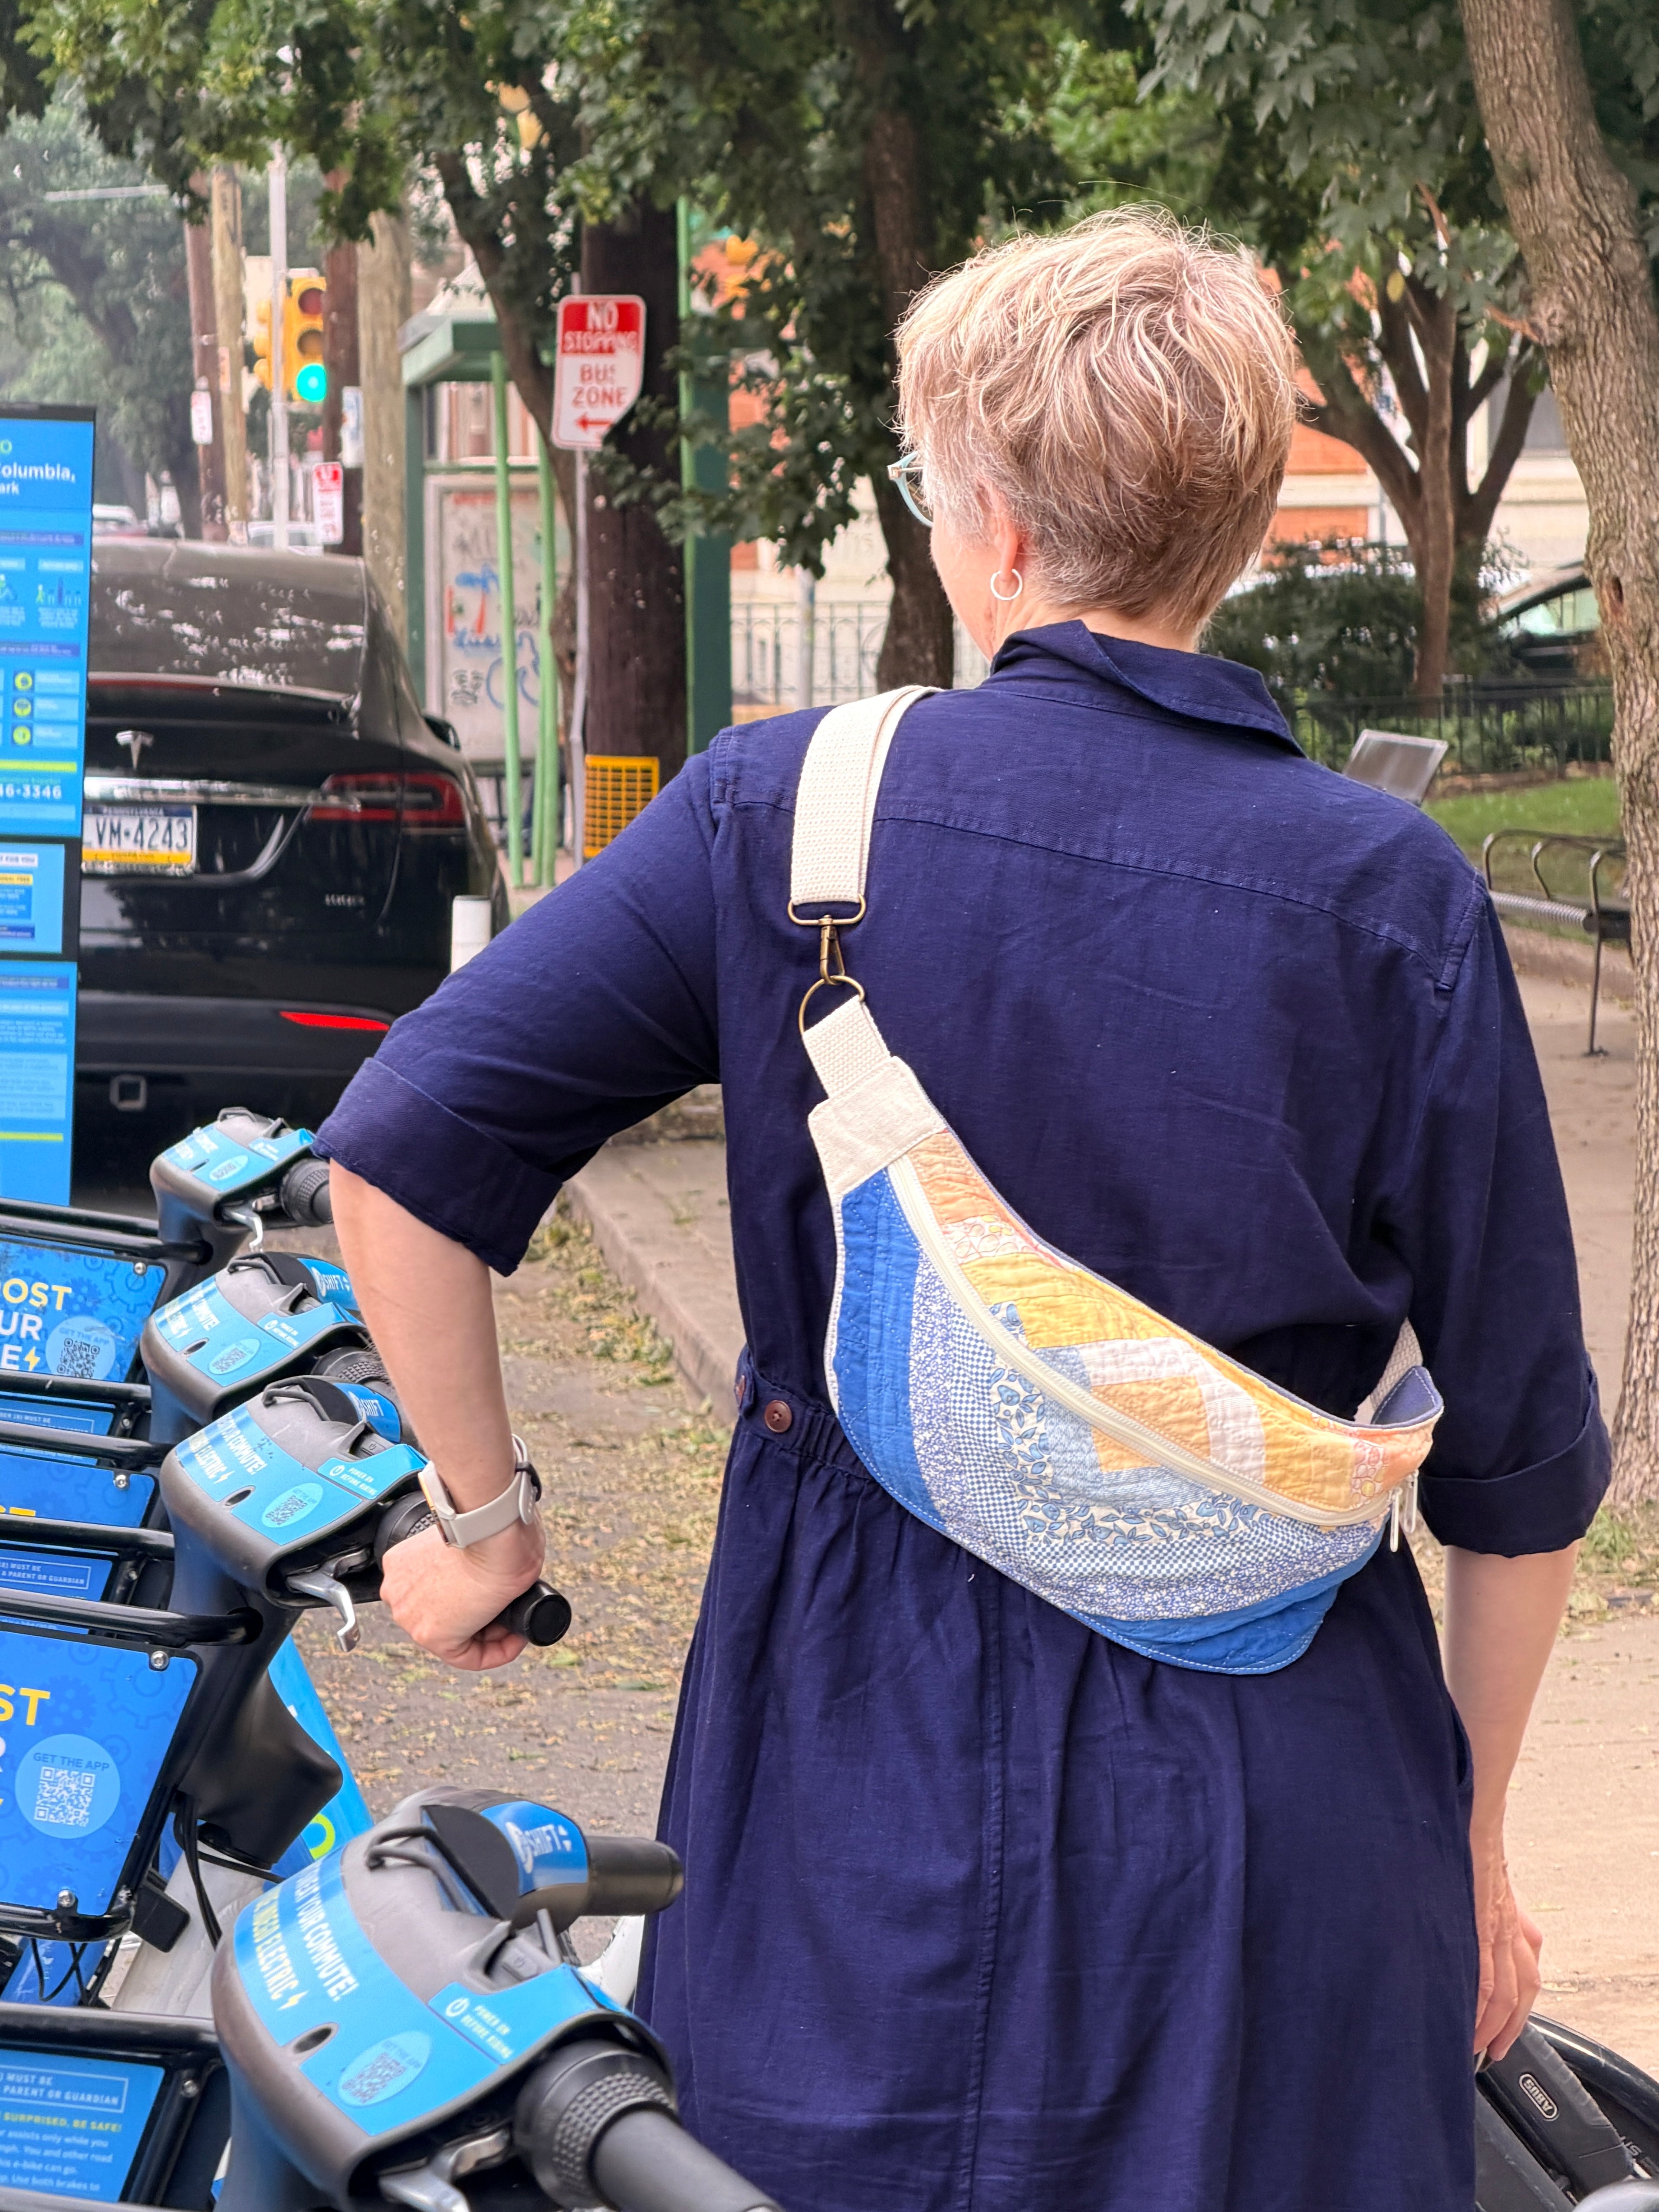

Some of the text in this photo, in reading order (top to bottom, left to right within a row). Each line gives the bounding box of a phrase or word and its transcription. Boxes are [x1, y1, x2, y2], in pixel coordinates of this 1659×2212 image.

[588, 302, 618, 330] NO
[572, 386, 627, 408] ZONE
[0, 462, 76, 483] olumbia,
[322, 1273, 344, 1291] SHIFT
[0, 1278, 72, 1310] OST
[364, 1399, 384, 1417] SHIFT
[226, 1434, 268, 1475] COMMUTE!
[8, 1571, 36, 1580] PARENT
[49, 1575, 85, 1585] GUARDIAN
[33, 1752, 110, 1772] GET THE APP
[525, 1824, 562, 1857] SHIFT
[255, 1932, 299, 2001] ELECTRIC
[303, 1922, 360, 2002] COMMUTE!
[6, 2072, 53, 2086] MUST BE
[3, 2085, 119, 2105] PARENT OR GUARDIAN
[1523, 2078, 1553, 2112] ABUS
[72, 2119, 87, 2129] BE
[89, 2121, 122, 2133] SAFE!
[42, 2133, 62, 2144] only
[63, 2135, 89, 2146] while
[90, 2140, 108, 2148] you
[13, 2160, 43, 2171] e-bike
[44, 2163, 62, 2172] can
[43, 2149, 62, 2158] and
[62, 2150, 89, 2160] other
[89, 2153, 114, 2163] road
